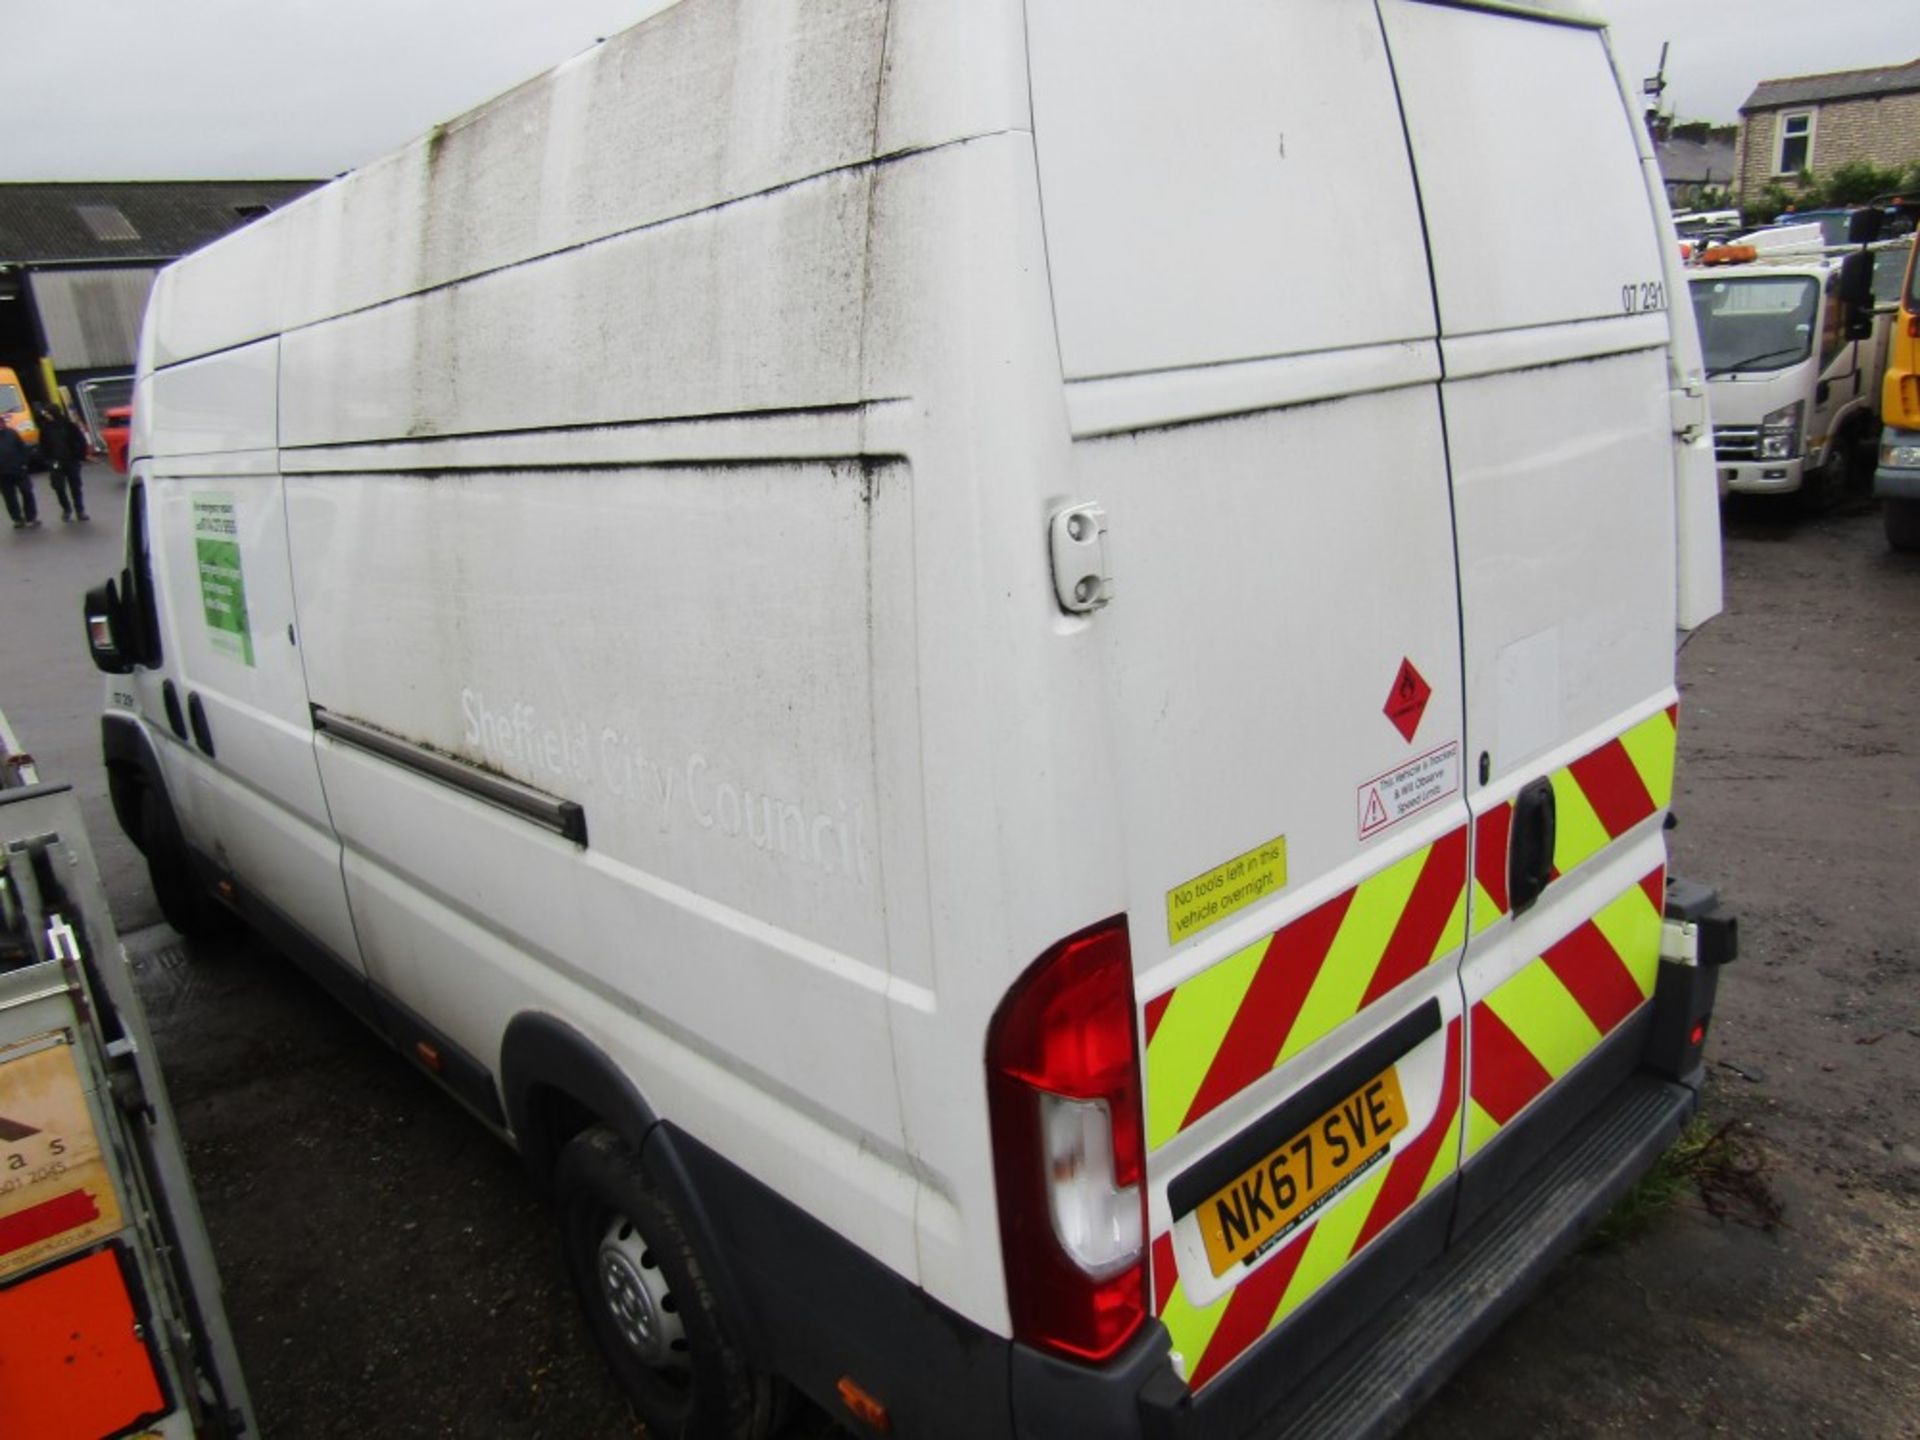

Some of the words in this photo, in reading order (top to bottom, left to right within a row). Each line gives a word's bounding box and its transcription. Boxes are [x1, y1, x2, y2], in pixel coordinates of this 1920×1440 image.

[1622, 284, 1637, 312] 07
[1641, 280, 1665, 310] 291
[461, 688, 588, 779] Sheffield
[600, 727, 674, 834] City
[686, 752, 868, 884] Council
[1174, 890, 1193, 908] No
[1195, 874, 1224, 898] tools
[1226, 861, 1245, 881] left
[1247, 857, 1258, 873] in
[1260, 846, 1280, 866] this
[1176, 902, 1218, 932] vehicle
[1220, 871, 1274, 910] overnight
[1216, 1135, 1314, 1254] NK67
[1323, 1080, 1393, 1168] SVE
